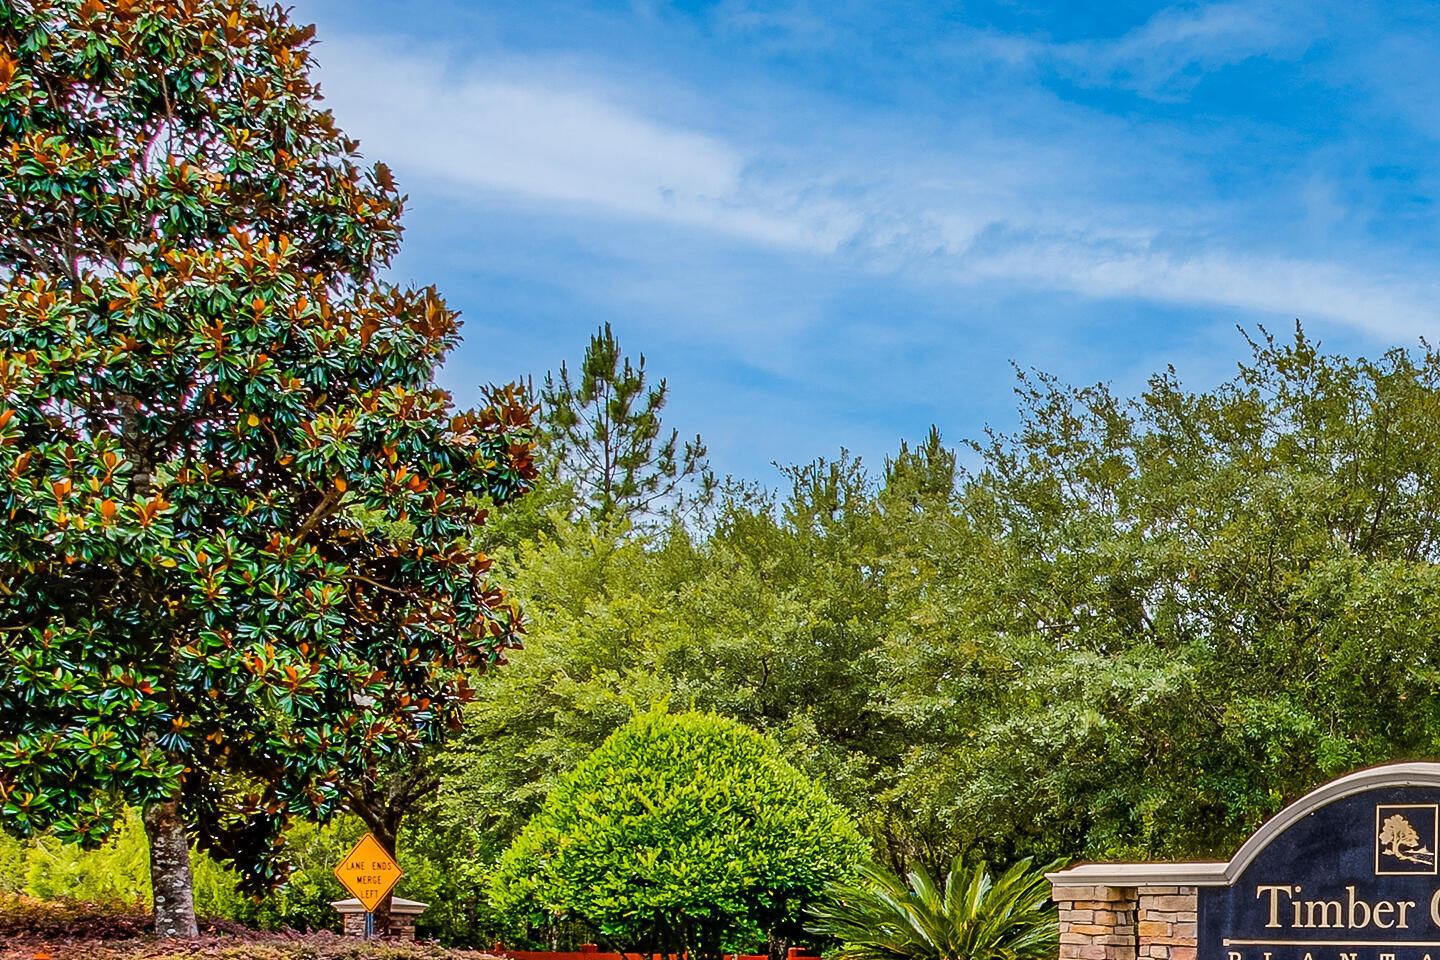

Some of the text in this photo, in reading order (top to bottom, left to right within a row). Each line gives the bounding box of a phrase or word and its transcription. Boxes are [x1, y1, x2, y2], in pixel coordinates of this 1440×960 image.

[346, 862, 392, 870] LANE ENDS
[357, 876, 382, 884] MERGE
[361, 890, 378, 898] LEFT
[1256, 885, 1416, 929] Timber
